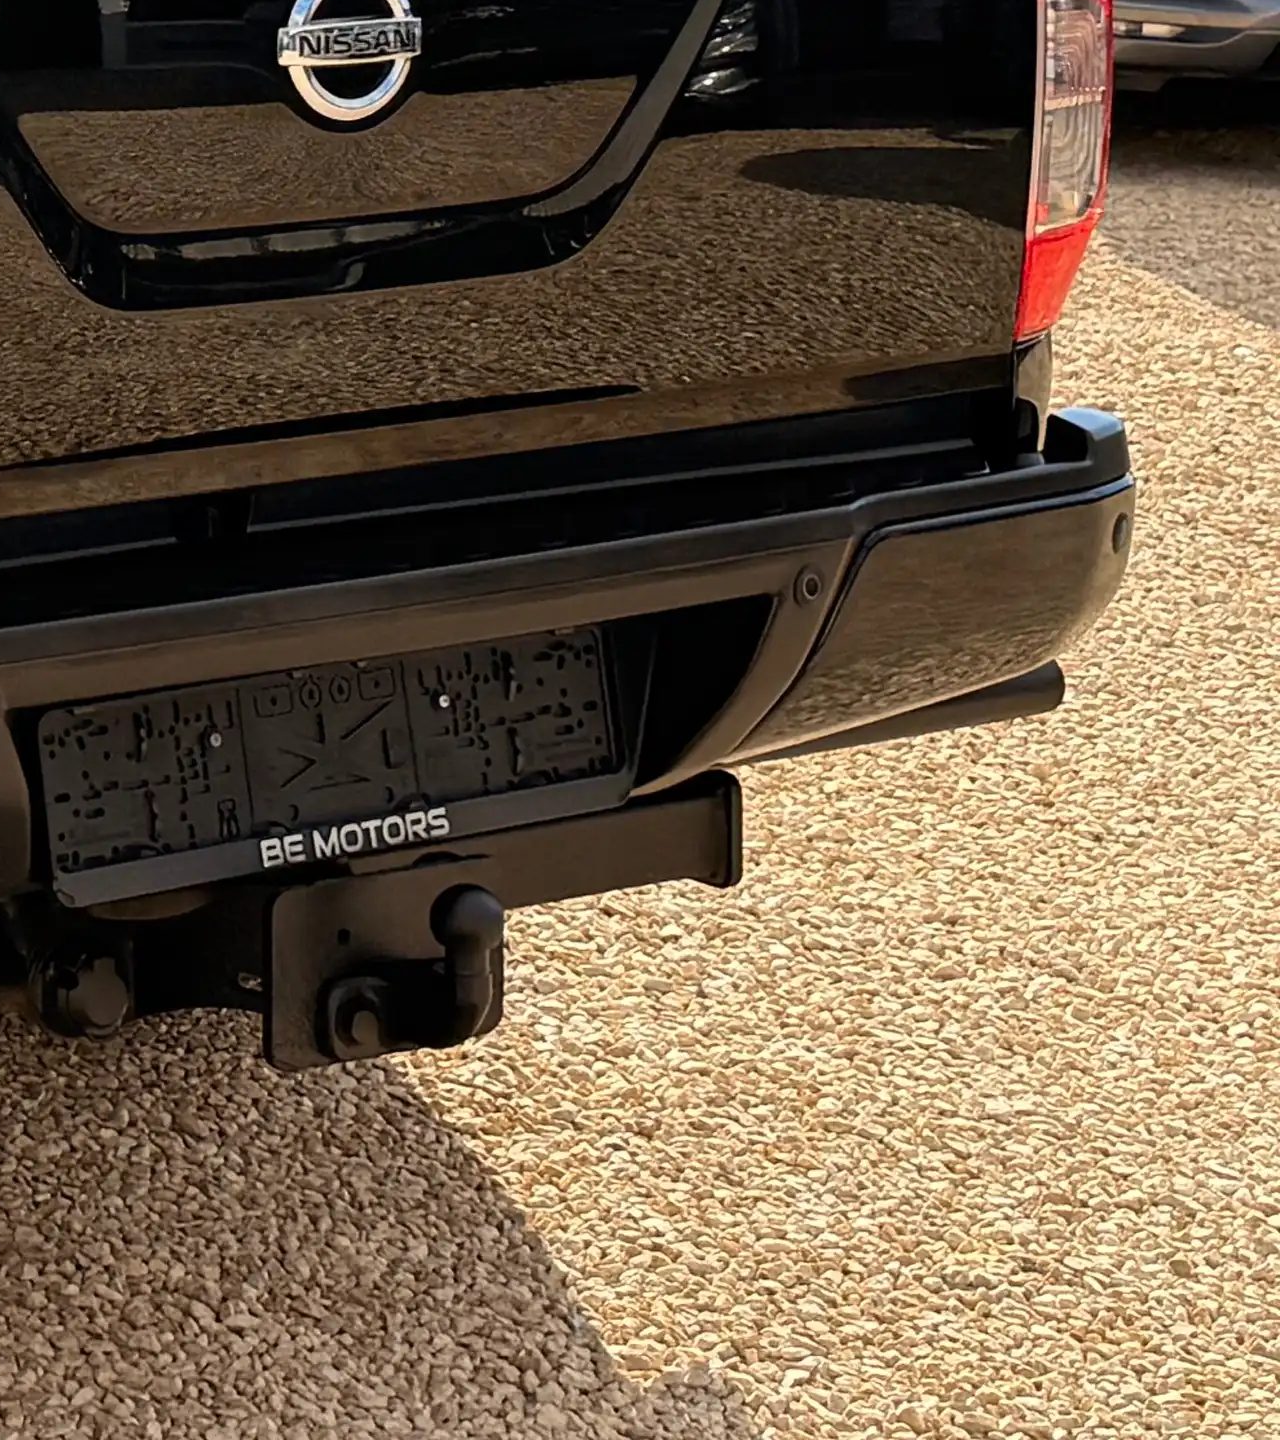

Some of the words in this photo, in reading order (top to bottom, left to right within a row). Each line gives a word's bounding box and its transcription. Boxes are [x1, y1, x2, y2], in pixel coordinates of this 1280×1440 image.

[298, 28, 416, 57] NISSAN
[260, 833, 307, 868] BE
[312, 807, 450, 859] MOTORS
